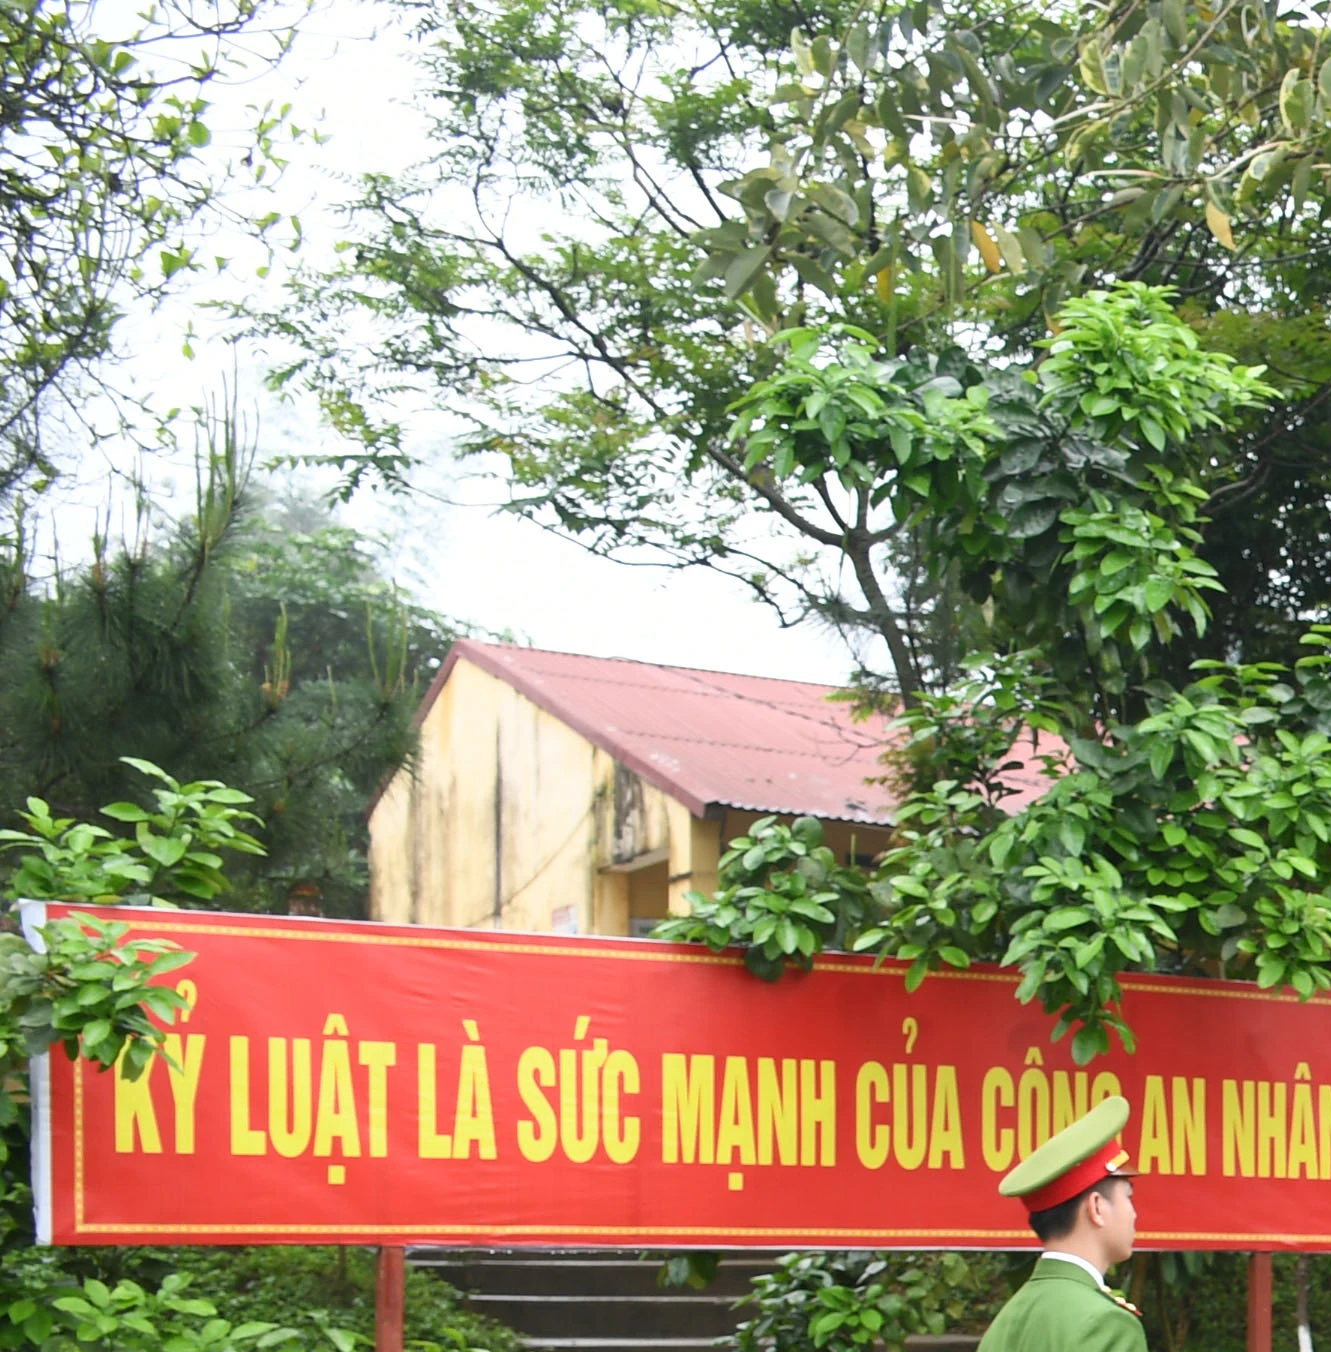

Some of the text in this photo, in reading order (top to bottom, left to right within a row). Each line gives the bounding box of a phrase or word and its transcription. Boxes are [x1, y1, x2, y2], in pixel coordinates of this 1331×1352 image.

[115, 979, 206, 1154] KỶ
[229, 1013, 396, 1185] LUẬT
[417, 1019, 497, 1160] LÀ
[517, 1015, 640, 1164] SỨC
[661, 1052, 836, 1191] MẠNH
[855, 1016, 964, 1170] CỦA
[981, 1046, 1122, 1172] CÔN
[1138, 1075, 1206, 1176] AN
